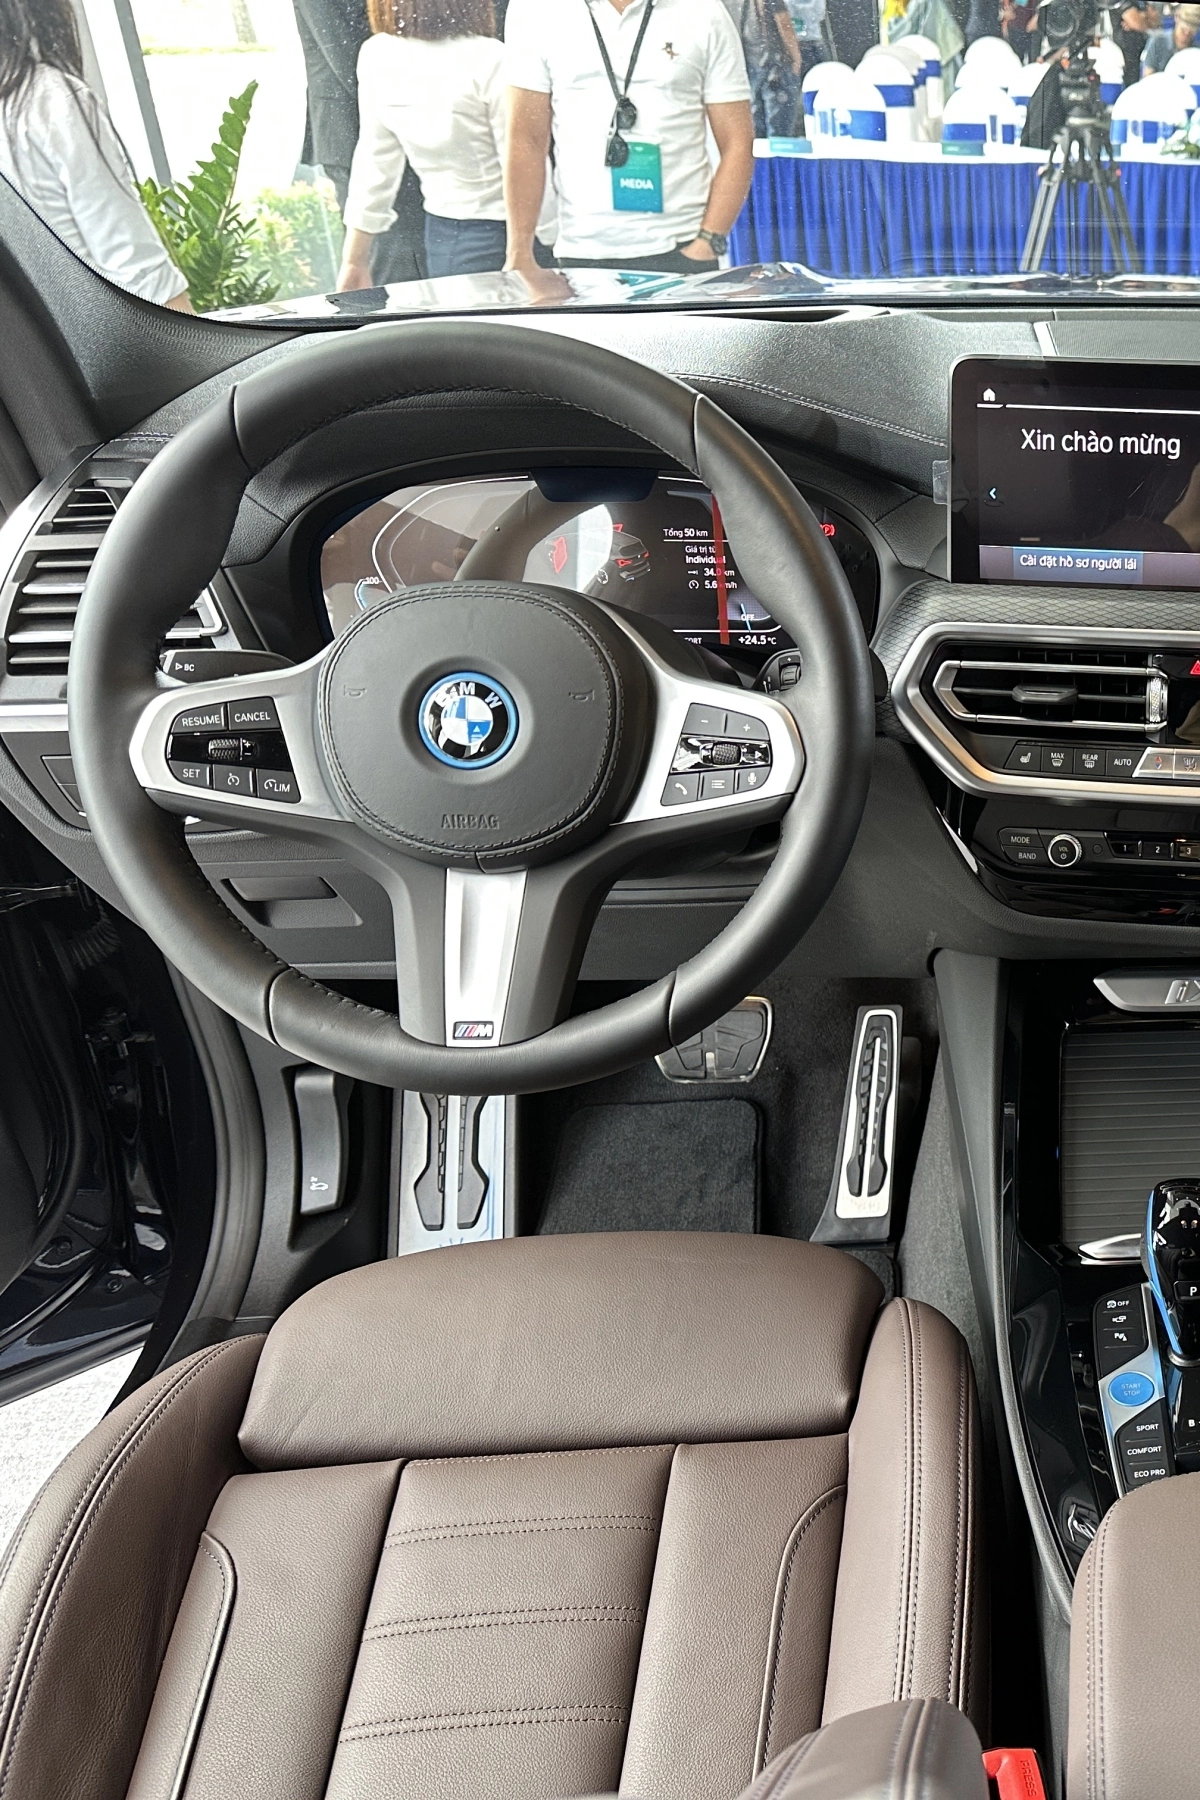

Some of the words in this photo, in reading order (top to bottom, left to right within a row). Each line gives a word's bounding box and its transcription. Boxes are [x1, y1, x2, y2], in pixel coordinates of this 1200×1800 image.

[620, 177, 654, 190] MEDIA
[1021, 428, 1055, 451] Xin
[1061, 430, 1113, 453] chào
[1119, 433, 1181, 460] mừng
[663, 528, 683, 538] Tổng
[684, 528, 695, 537] 50
[696, 529, 708, 537] km
[685, 556, 726, 564] Individual
[1020, 554, 1037, 566] Cài
[1039, 555, 1057, 568] đặt
[1059, 555, 1074, 567] hồ
[1075, 557, 1089, 568] sơ
[1091, 557, 1122, 571] người
[1124, 557, 1137, 570] lái
[704, 568, 721, 577] 34.0
[704, 581, 718, 589] 5.6
[719, 581, 737, 589] m/h
[184, 663, 195, 672] BC
[182, 714, 221, 728] RESUME
[234, 711, 271, 722] CANCEL
[182, 768, 201, 778] SET
[274, 782, 290, 793] LIM
[441, 814, 500, 829] AIRBAG
[1018, 852, 1036, 860] BAND
[1189, 1286, 1197, 1296] P
[1136, 1423, 1159, 1432] SPORT
[1189, 1419, 1195, 1427] B
[1127, 1445, 1162, 1456] COMFORT
[1134, 1470, 1149, 1479] ECO
[1151, 1468, 1165, 1477] PRO
[1020, 1760, 1037, 1797] PRESS
